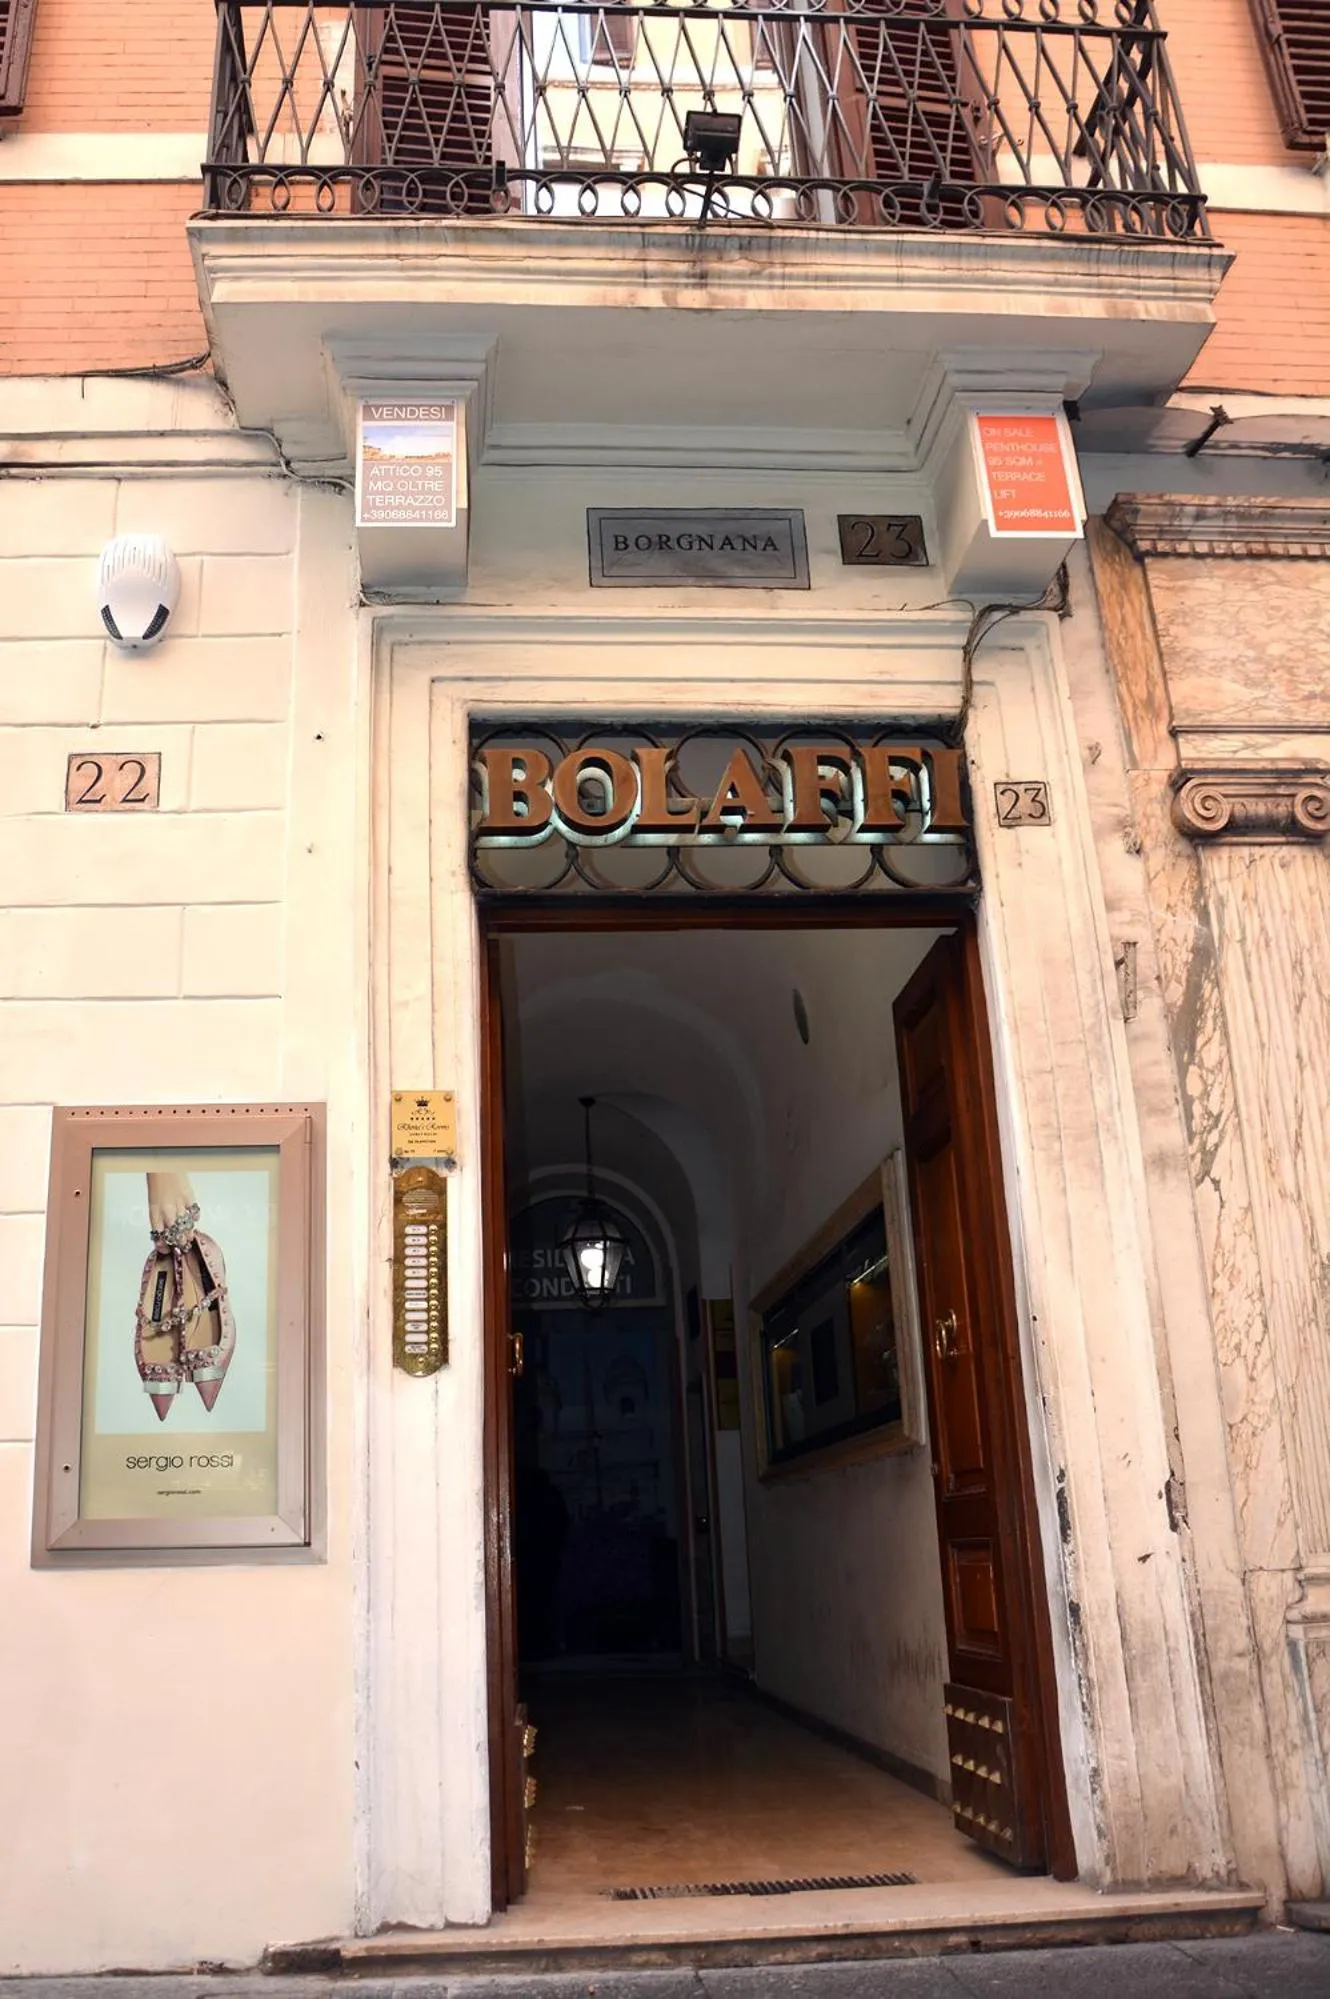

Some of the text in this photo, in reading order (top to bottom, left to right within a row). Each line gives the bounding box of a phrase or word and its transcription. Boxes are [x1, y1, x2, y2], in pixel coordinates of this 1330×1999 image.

[370, 406, 446, 419] VENDESI
[370, 465, 443, 477] ATTICO 95
[368, 480, 445, 492] MQ OLTRE
[366, 495, 446, 507] TERRAZZO
[613, 532, 780, 552] BORGNANA
[850, 520, 914, 559] 23
[75, 760, 150, 805] 22
[476, 747, 969, 832] BOLAFFI
[999, 787, 1046, 821] 23
[125, 1453, 234, 1472] sergio rossi
